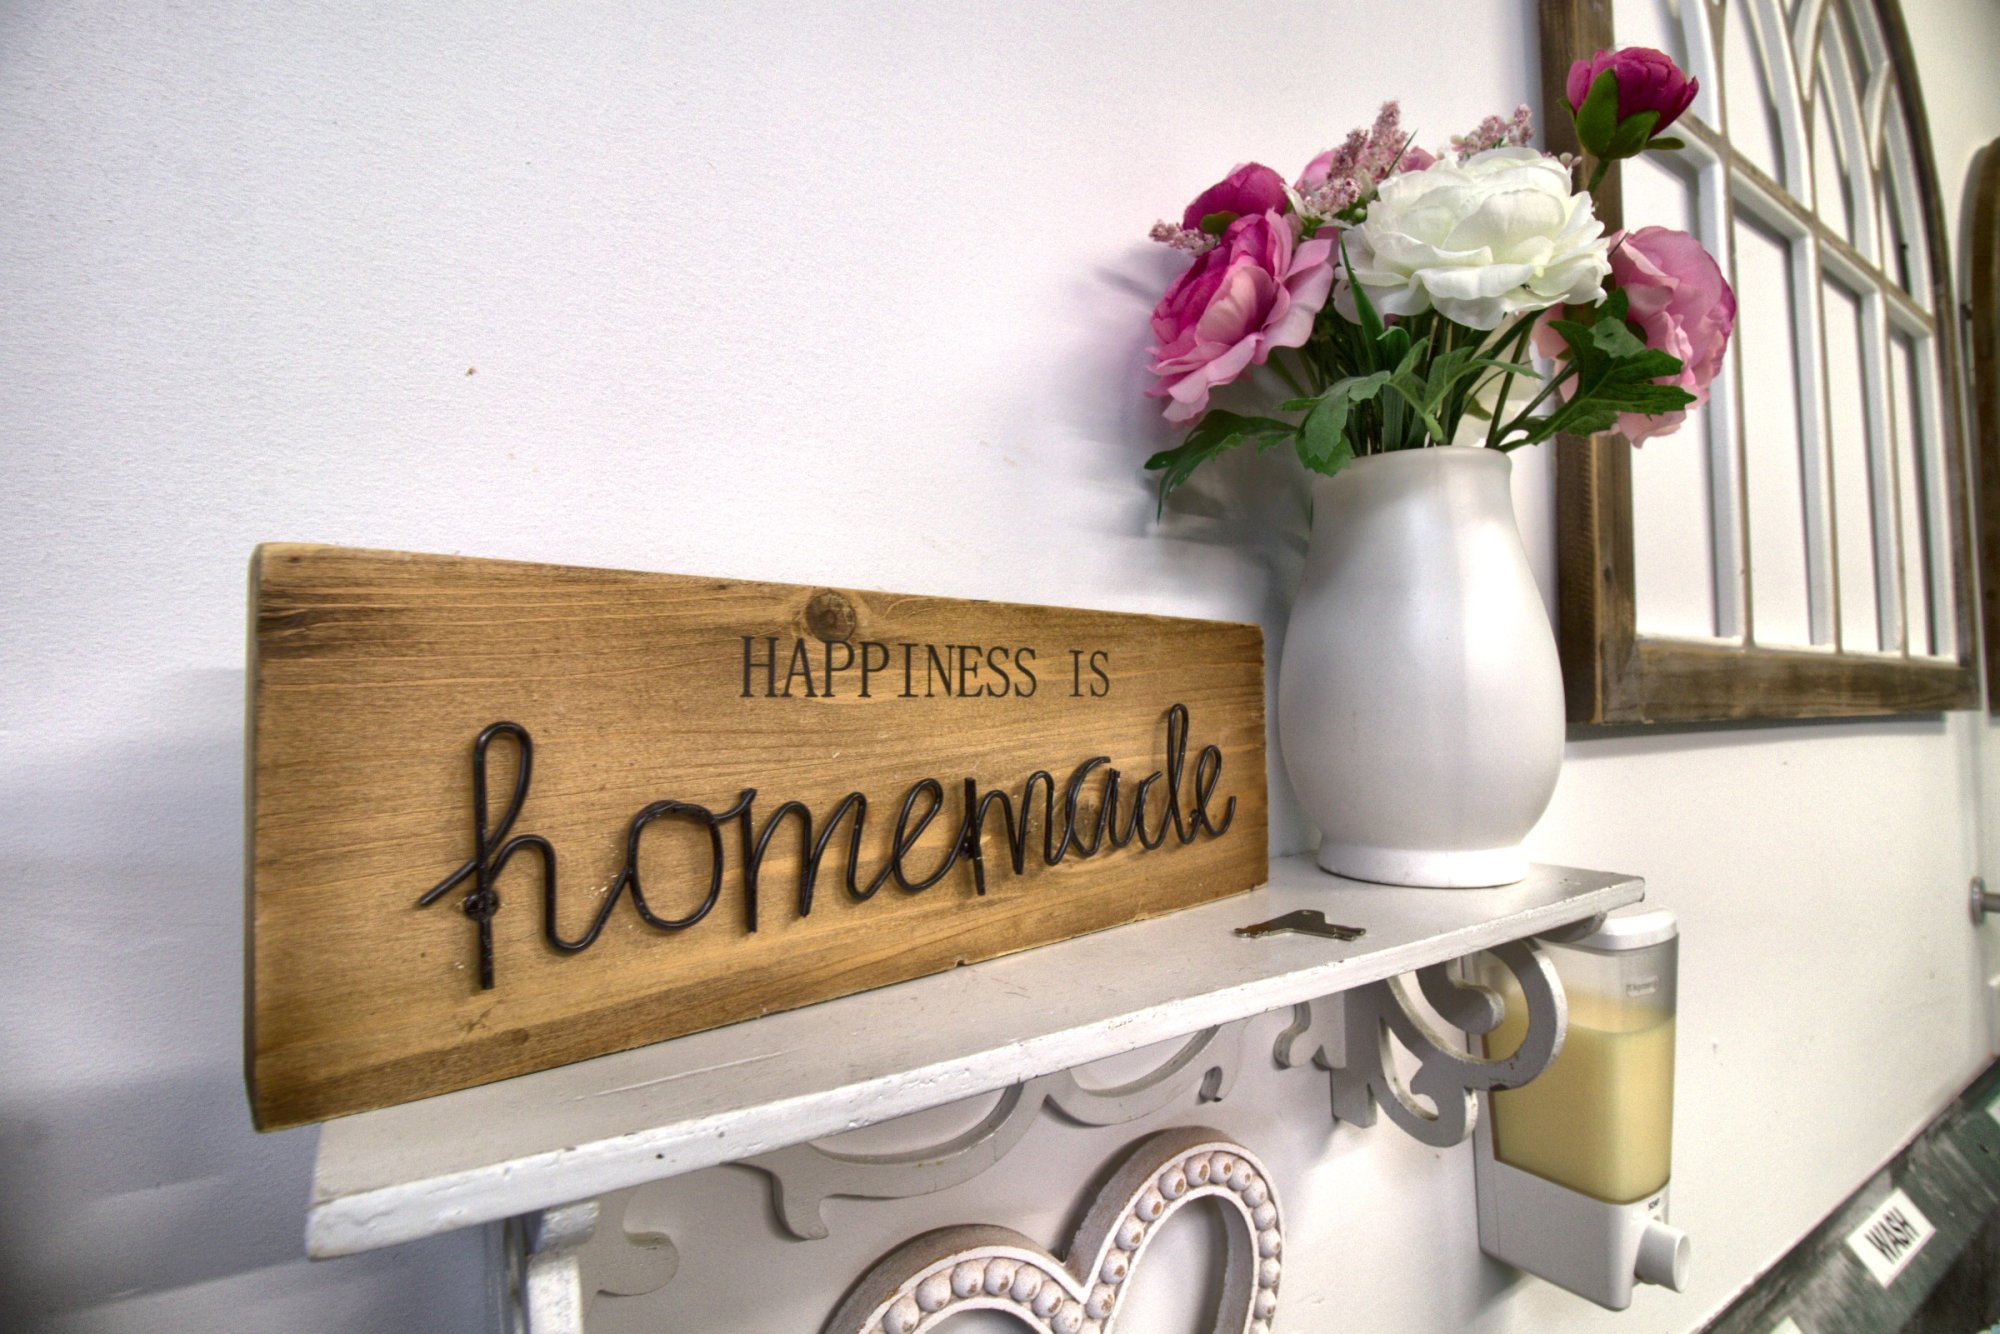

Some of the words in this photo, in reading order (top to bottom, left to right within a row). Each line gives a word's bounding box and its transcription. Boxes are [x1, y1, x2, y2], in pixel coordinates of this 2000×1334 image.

[740, 635, 1037, 698] HAPPINESS
[1069, 649, 1110, 698] IS
[419, 703, 1237, 989] homemade
[1864, 1206, 1920, 1264] WASH
